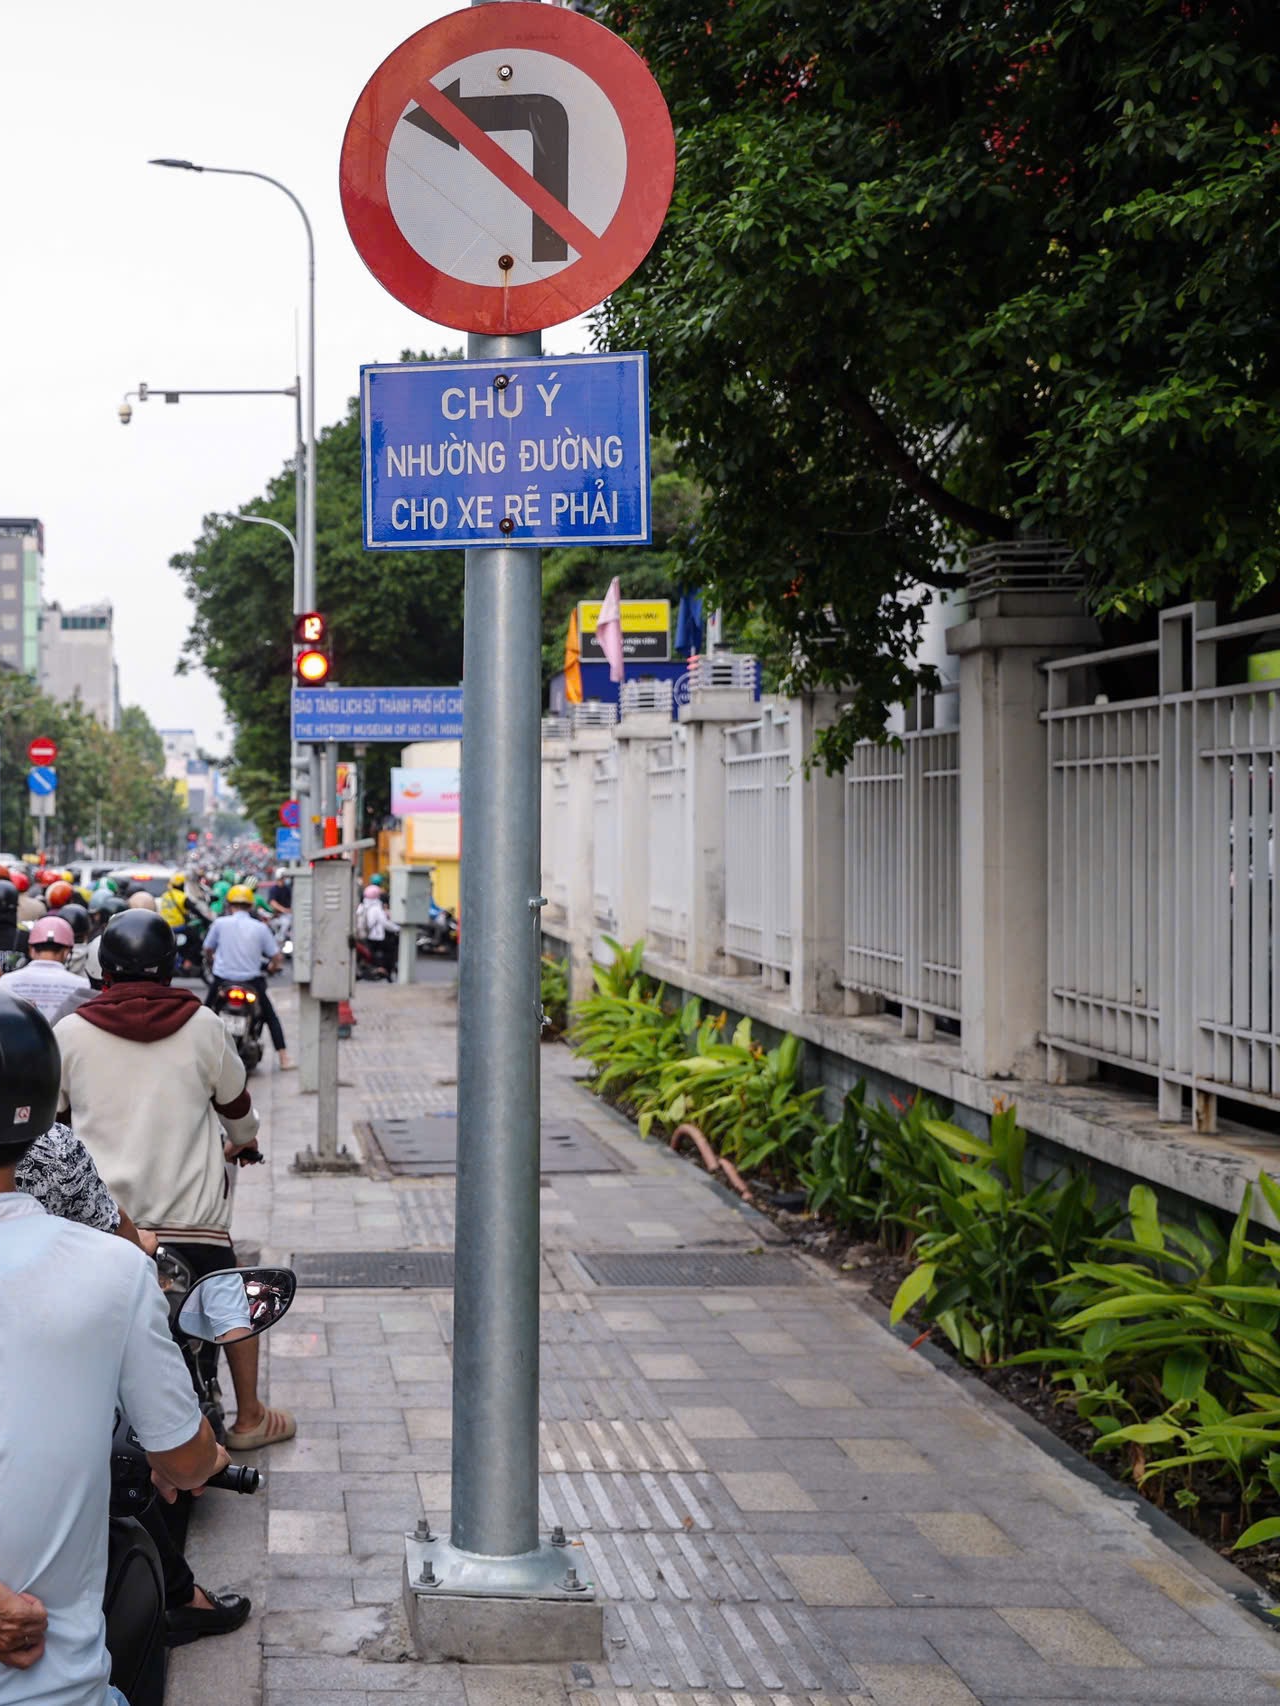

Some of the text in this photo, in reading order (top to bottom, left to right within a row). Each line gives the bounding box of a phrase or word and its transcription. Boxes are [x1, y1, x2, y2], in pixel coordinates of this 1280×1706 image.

[441, 371, 562, 421] CHÚ Ý
[386, 427, 624, 478] NHƯỜNG ĐƯỜNG
[391, 479, 619, 531] CHO XE RẼ PHẢI
[315, 723, 352, 736] HISTORY
[354, 723, 393, 736] MUSEUM
